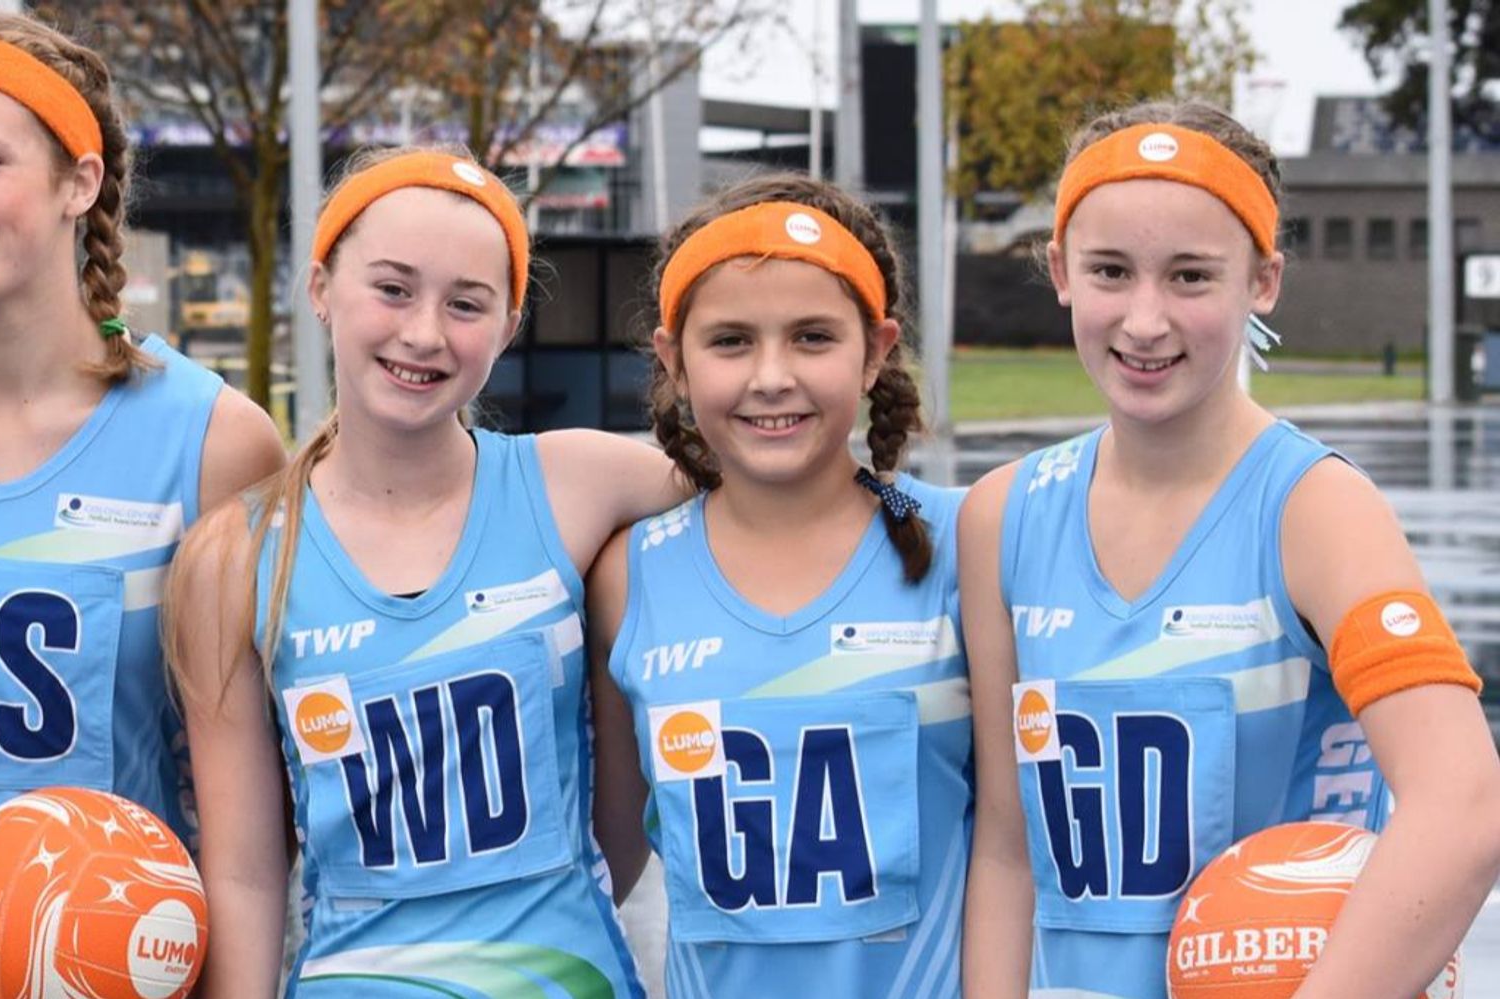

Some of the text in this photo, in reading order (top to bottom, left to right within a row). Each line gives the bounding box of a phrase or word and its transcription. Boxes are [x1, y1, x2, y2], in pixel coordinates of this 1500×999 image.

[290, 619, 377, 658] TWP
[642, 636, 724, 681] TWP
[300, 708, 351, 734] LUMO
[662, 729, 716, 753] LUMO
[338, 668, 530, 868] WD
[690, 723, 879, 914] GA
[1035, 710, 1194, 903] GD
[137, 935, 196, 966] LUMO
[1176, 926, 1329, 971] GILBER
